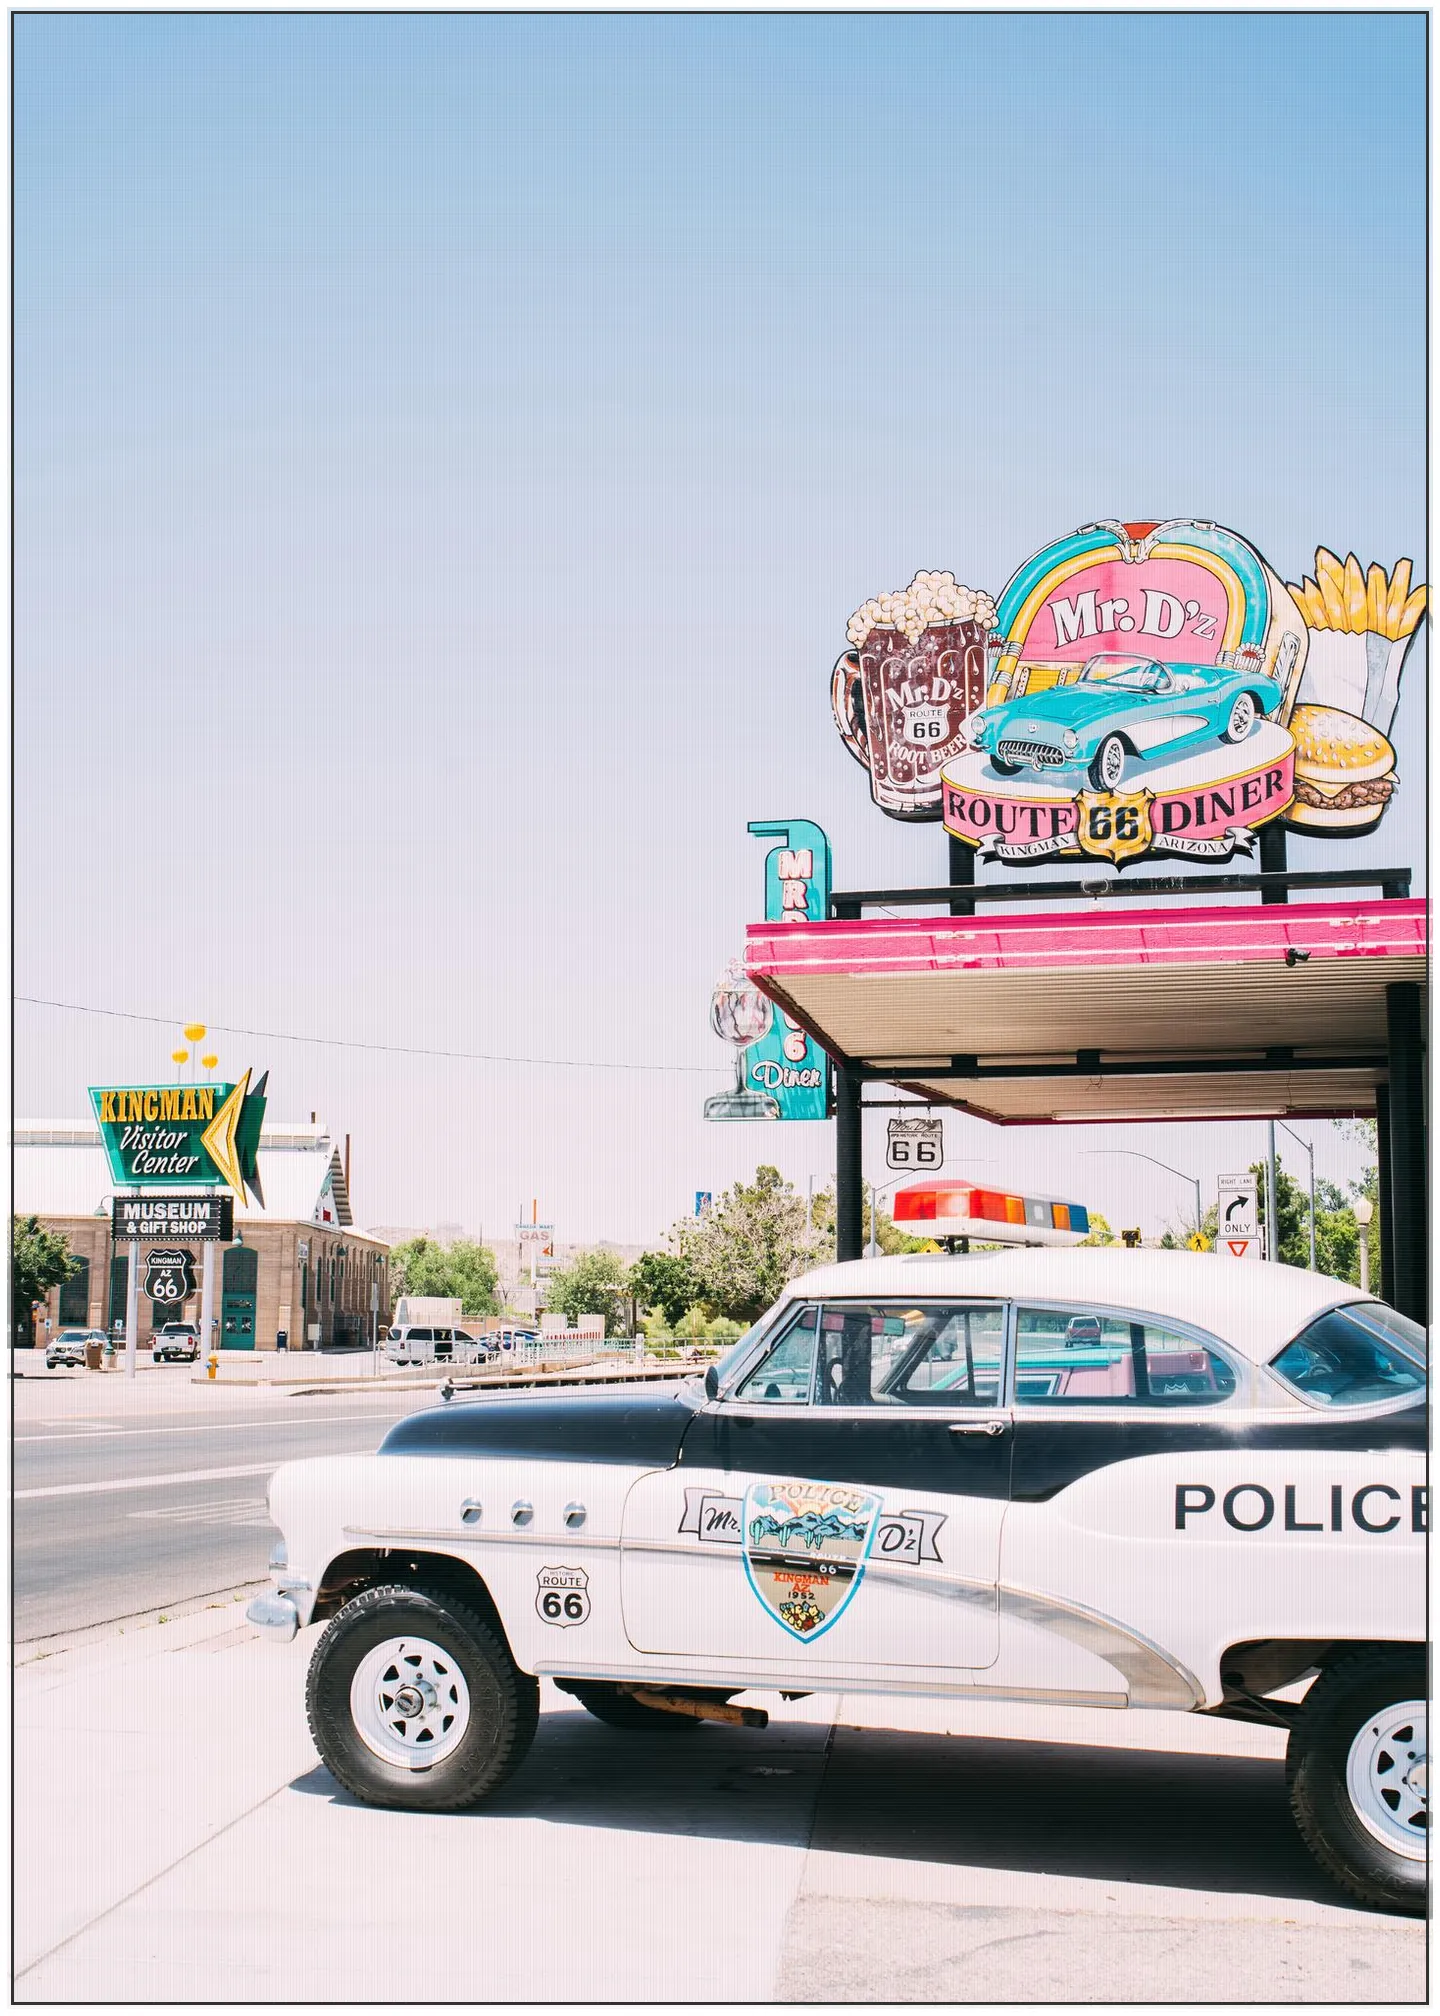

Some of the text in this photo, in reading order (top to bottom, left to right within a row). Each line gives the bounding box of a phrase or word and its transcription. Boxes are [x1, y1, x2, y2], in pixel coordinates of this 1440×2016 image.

[1047, 589, 1136, 649] Mr.
[885, 679, 930, 712] Mr.
[909, 709, 943, 718] ROUTE
[913, 722, 941, 739] 66
[889, 733, 967, 764] ROOT BEER
[948, 768, 1285, 842] ROUTE 66 DINER
[998, 834, 1229, 858] KINGMAN ARIZONA
[752, 1060, 822, 1090] Diner
[99, 1087, 215, 1123] KINGMAN
[119, 1125, 188, 1151] Visitor
[131, 1149, 199, 1174] Center
[892, 1141, 936, 1162] 66
[123, 1203, 211, 1220] MUSEUM
[126, 1221, 207, 1234] & GIFT SHOP
[520, 1230, 549, 1240] GAS
[1225, 1223, 1251, 1233] ONLY
[151, 1256, 182, 1265] KINGMAN
[160, 1270, 172, 1278] AZ
[153, 1278, 178, 1298] 66
[769, 1485, 864, 1513] POLICE
[1175, 1483, 1431, 1534] POLICE
[704, 1507, 741, 1533] Mr.
[773, 1571, 829, 1586] KINGMAN
[819, 1564, 837, 1575] 66
[543, 1576, 582, 1586] ROUTE
[791, 1584, 811, 1593] AZ
[543, 1592, 583, 1619] 66
[788, 1591, 816, 1600] 1952
